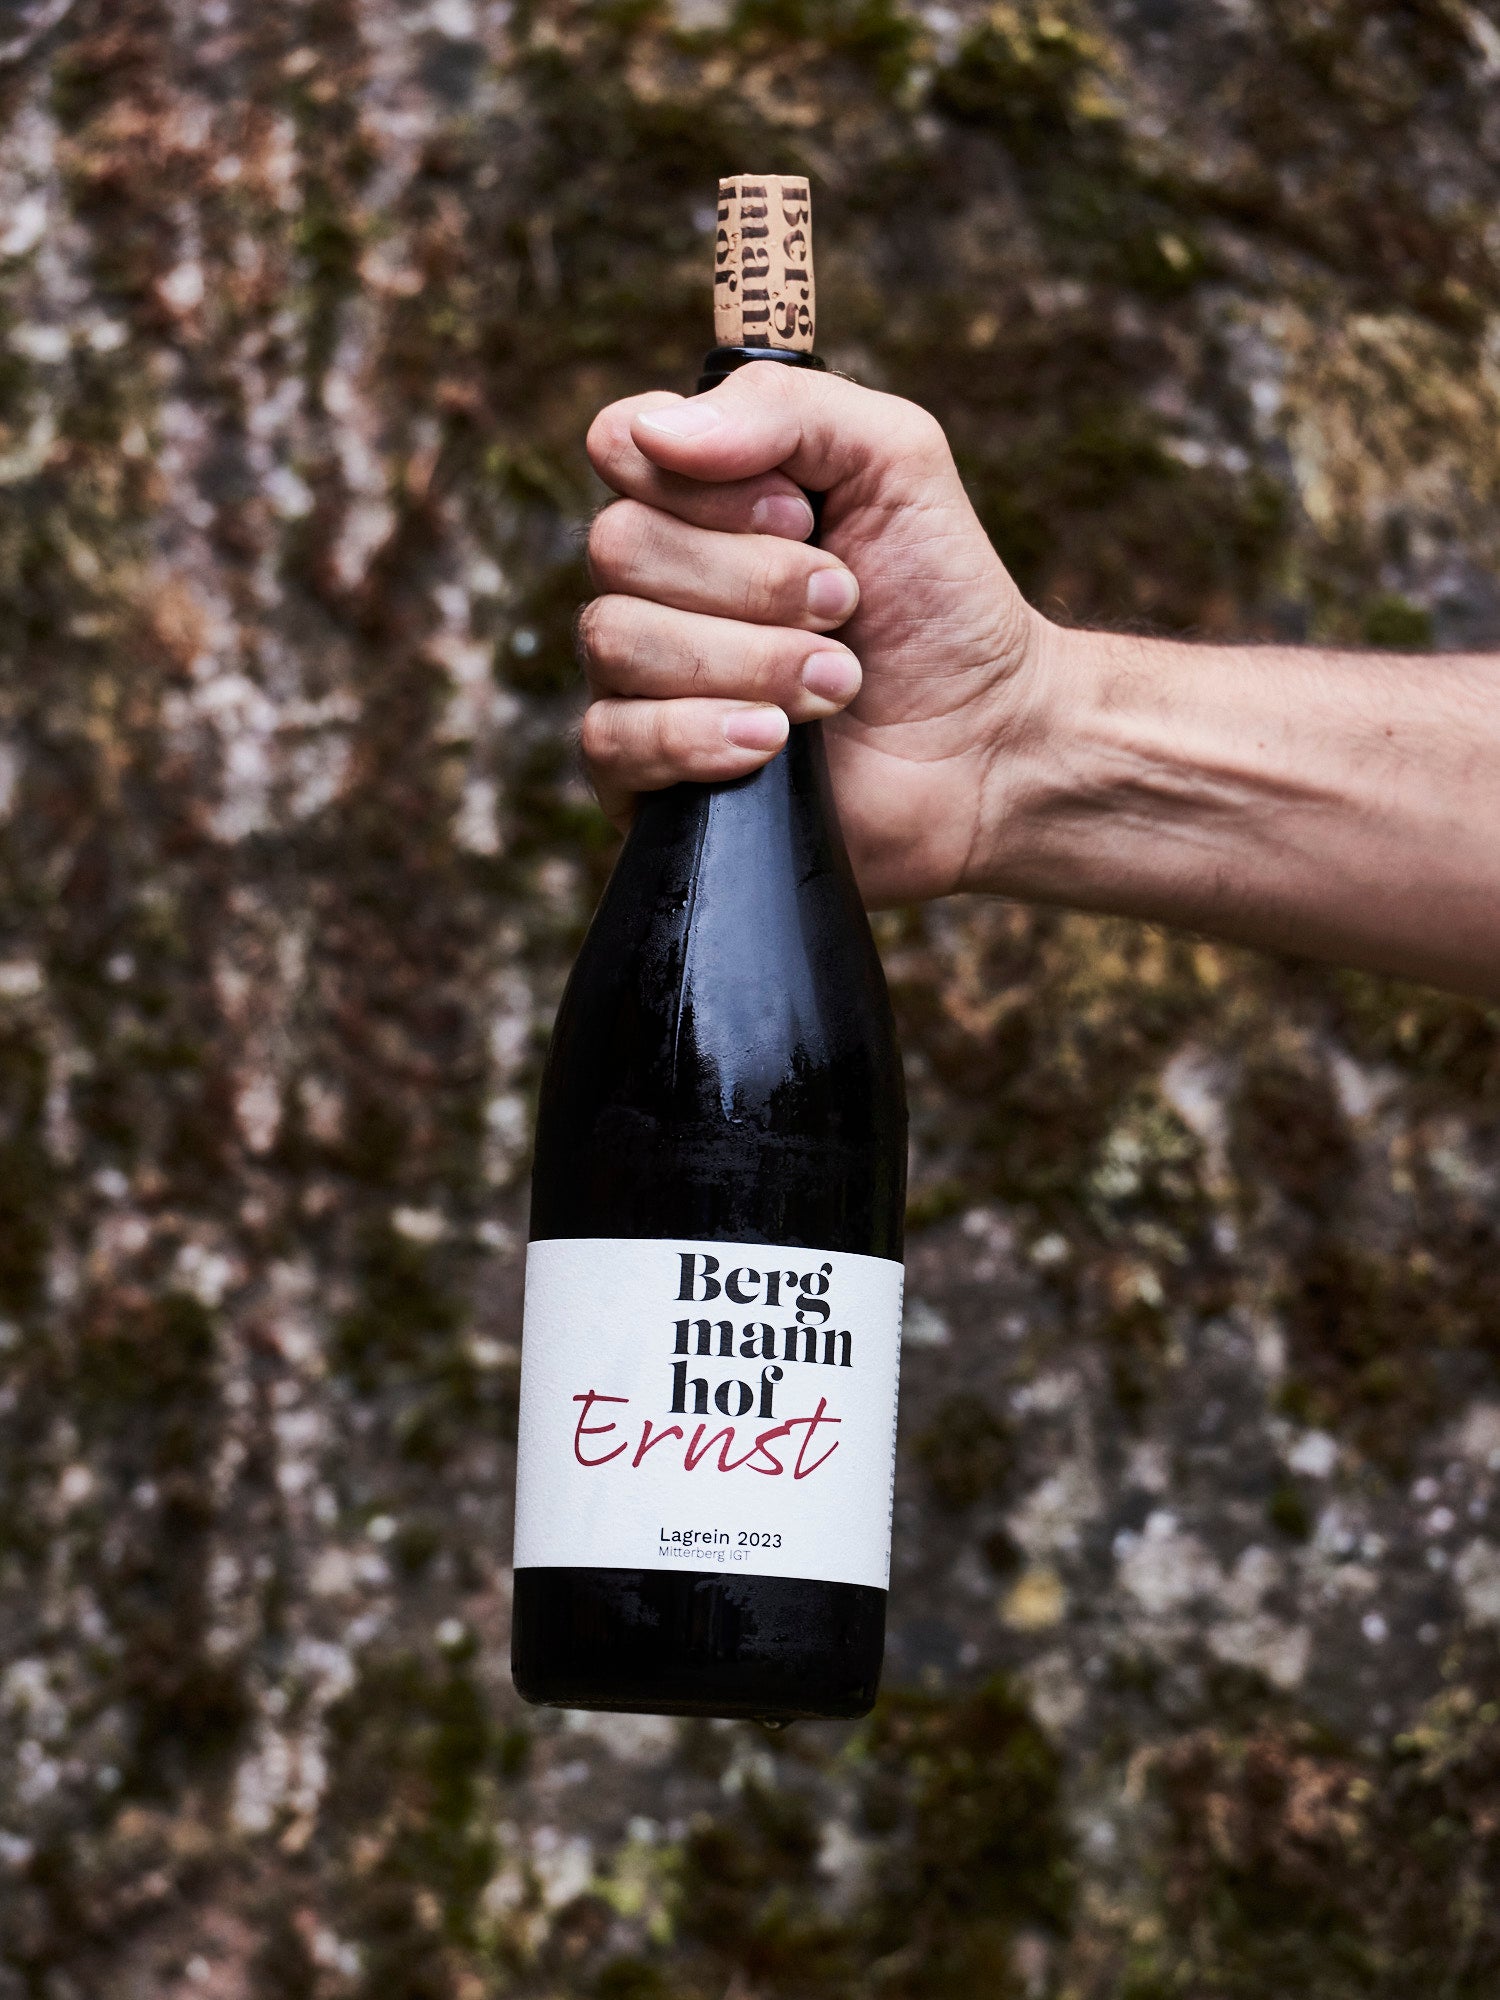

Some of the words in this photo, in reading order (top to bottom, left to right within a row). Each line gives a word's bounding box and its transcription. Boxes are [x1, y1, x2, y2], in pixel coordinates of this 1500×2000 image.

[775, 188, 814, 338] Berg
[673, 1252, 833, 1325] Berg
[670, 1318, 853, 1367] mann
[667, 1360, 784, 1419] hof
[572, 1389, 842, 1480] Ernst
[658, 1546, 726, 1562] Mitterberg
[729, 1549, 751, 1561] IGT
[660, 1527, 730, 1546] Lagrein
[738, 1531, 782, 1548] 2023
